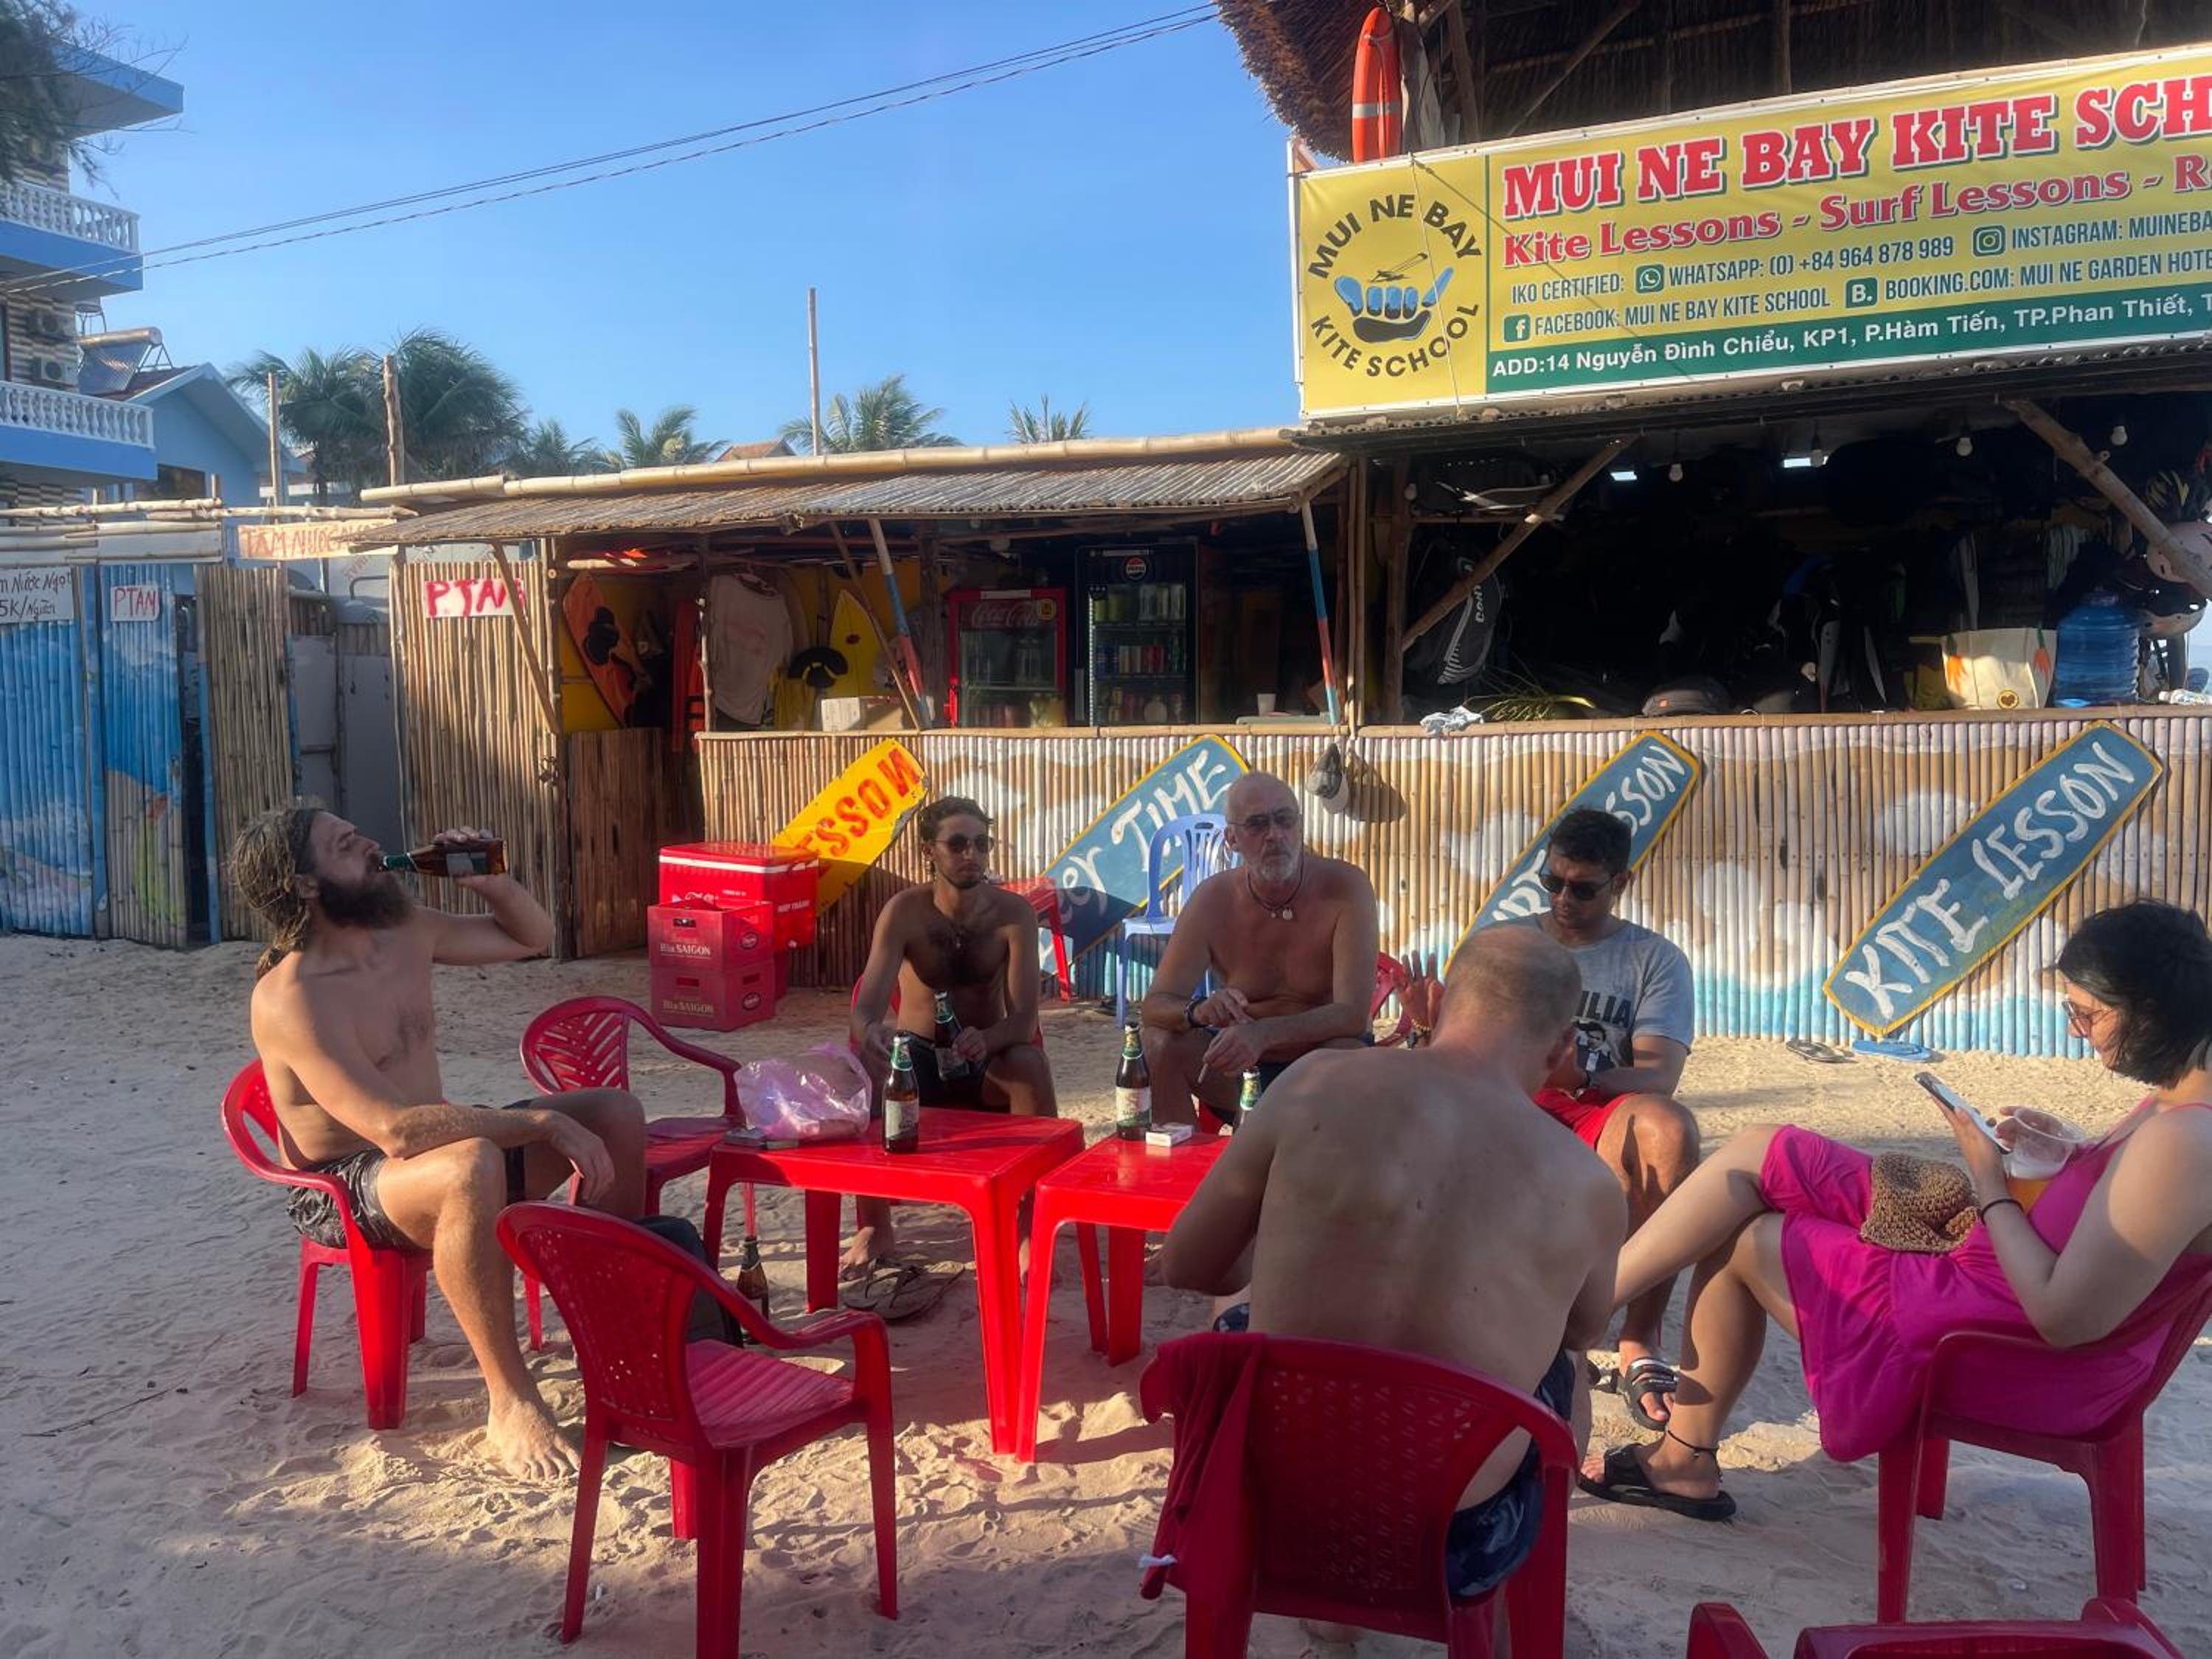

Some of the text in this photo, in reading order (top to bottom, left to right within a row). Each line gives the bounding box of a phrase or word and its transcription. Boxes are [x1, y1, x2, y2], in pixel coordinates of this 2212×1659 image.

[1503, 152, 1622, 220] MUI
[1637, 136, 1727, 201] NE
[1741, 118, 1877, 187] BAY
[1893, 93, 2059, 170] KITE
[1308, 194, 1482, 279] MUI NE BAY
[1503, 231, 1591, 268] Kite
[1600, 209, 1781, 257] Lessons
[1820, 184, 1924, 231] Surf
[1929, 170, 2132, 218] Lessons
[2174, 153, 2212, 193] R
[2012, 220, 2123, 248] INSTAGRAM:
[1512, 274, 1624, 304] IKO CERTIFIED:
[1669, 236, 1954, 286] WHATSAPP: (0) +84 964 878 989
[1885, 268, 2014, 300] BOOKING.COM:
[2020, 263, 2053, 286] MUI
[2060, 261, 2082, 282] NE
[2088, 254, 2161, 280] GARDEN
[1311, 303, 1479, 378] KITE SCHOOL
[1492, 354, 1570, 378] ADD:14
[1576, 344, 1657, 372] Nguyễn
[1664, 340, 1715, 361] Đình
[1804, 327, 1857, 348] KP1,
[1865, 321, 1938, 342] P.Hàm
[1947, 310, 2005, 334] Tiến,
[2014, 305, 2114, 327] TP.Phan
[2122, 293, 2194, 317] Thiết,
[1535, 308, 1620, 335] FACEBOOK:
[1625, 305, 1655, 326] MUI
[1660, 302, 1680, 321] NE
[1686, 299, 1718, 320] BAY
[1723, 295, 1759, 316] KITE
[1765, 288, 1830, 312] SCHOOL
[114, 587, 156, 618] PTAN
[1111, 749, 1232, 872] TIME
[1605, 745, 1685, 838] SSON
[1845, 741, 2135, 1019] KITE LESSON
[675, 944, 711, 956] SAIGON
